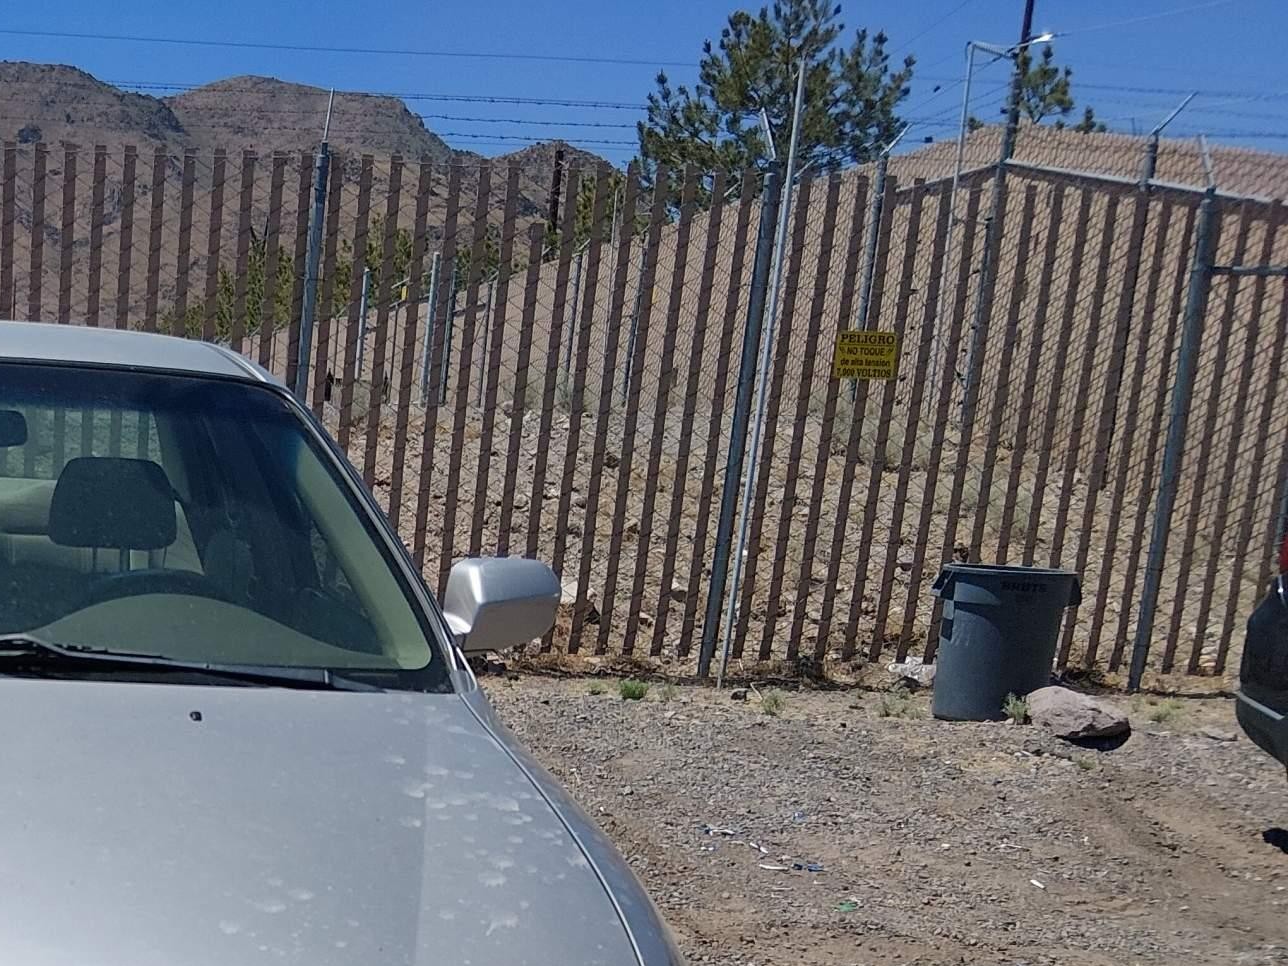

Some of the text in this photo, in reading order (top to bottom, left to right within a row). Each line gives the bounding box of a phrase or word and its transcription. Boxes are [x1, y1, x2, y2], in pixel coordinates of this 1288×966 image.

[841, 334, 894, 344] PELIGRO
[847, 347, 885, 356] NO TOQUE
[840, 358, 849, 366] de
[857, 368, 891, 378] VOLTIOS
